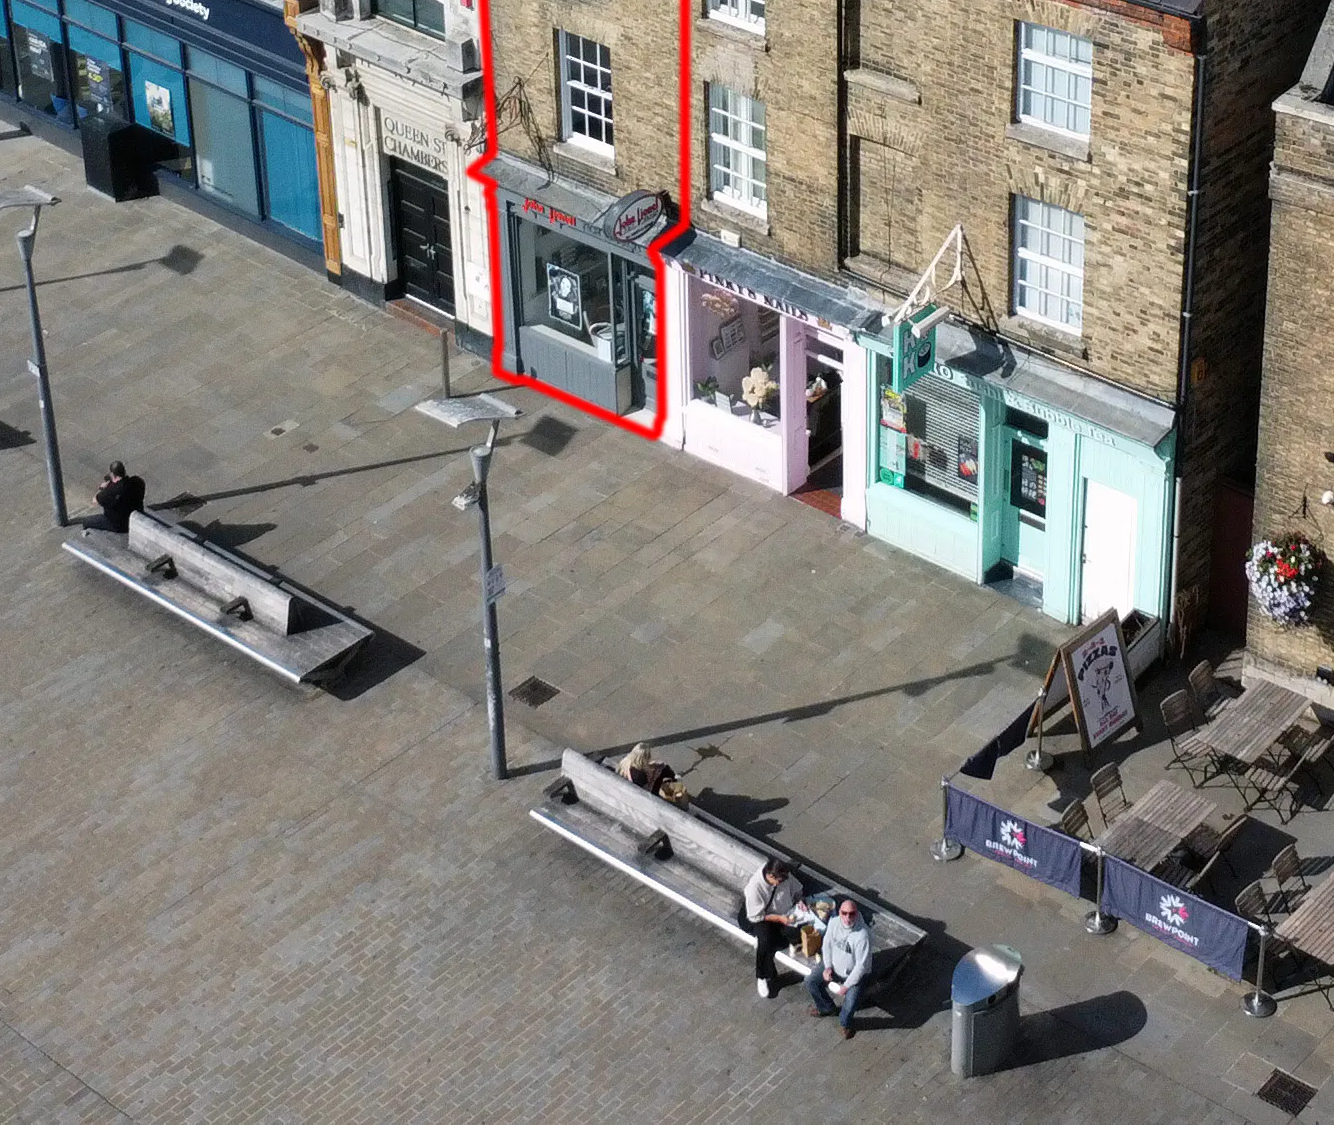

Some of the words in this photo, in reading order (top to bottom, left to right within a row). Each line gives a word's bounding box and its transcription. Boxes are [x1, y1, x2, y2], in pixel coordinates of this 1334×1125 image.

[384, 116, 430, 148] QUEEN
[433, 137, 447, 155] ST
[384, 135, 448, 174] CHAMBERS
[1078, 644, 1118, 682] PIZZAS
[985, 838, 1038, 869] BREWPOINT
[1145, 911, 1200, 947] BREWPOINT
